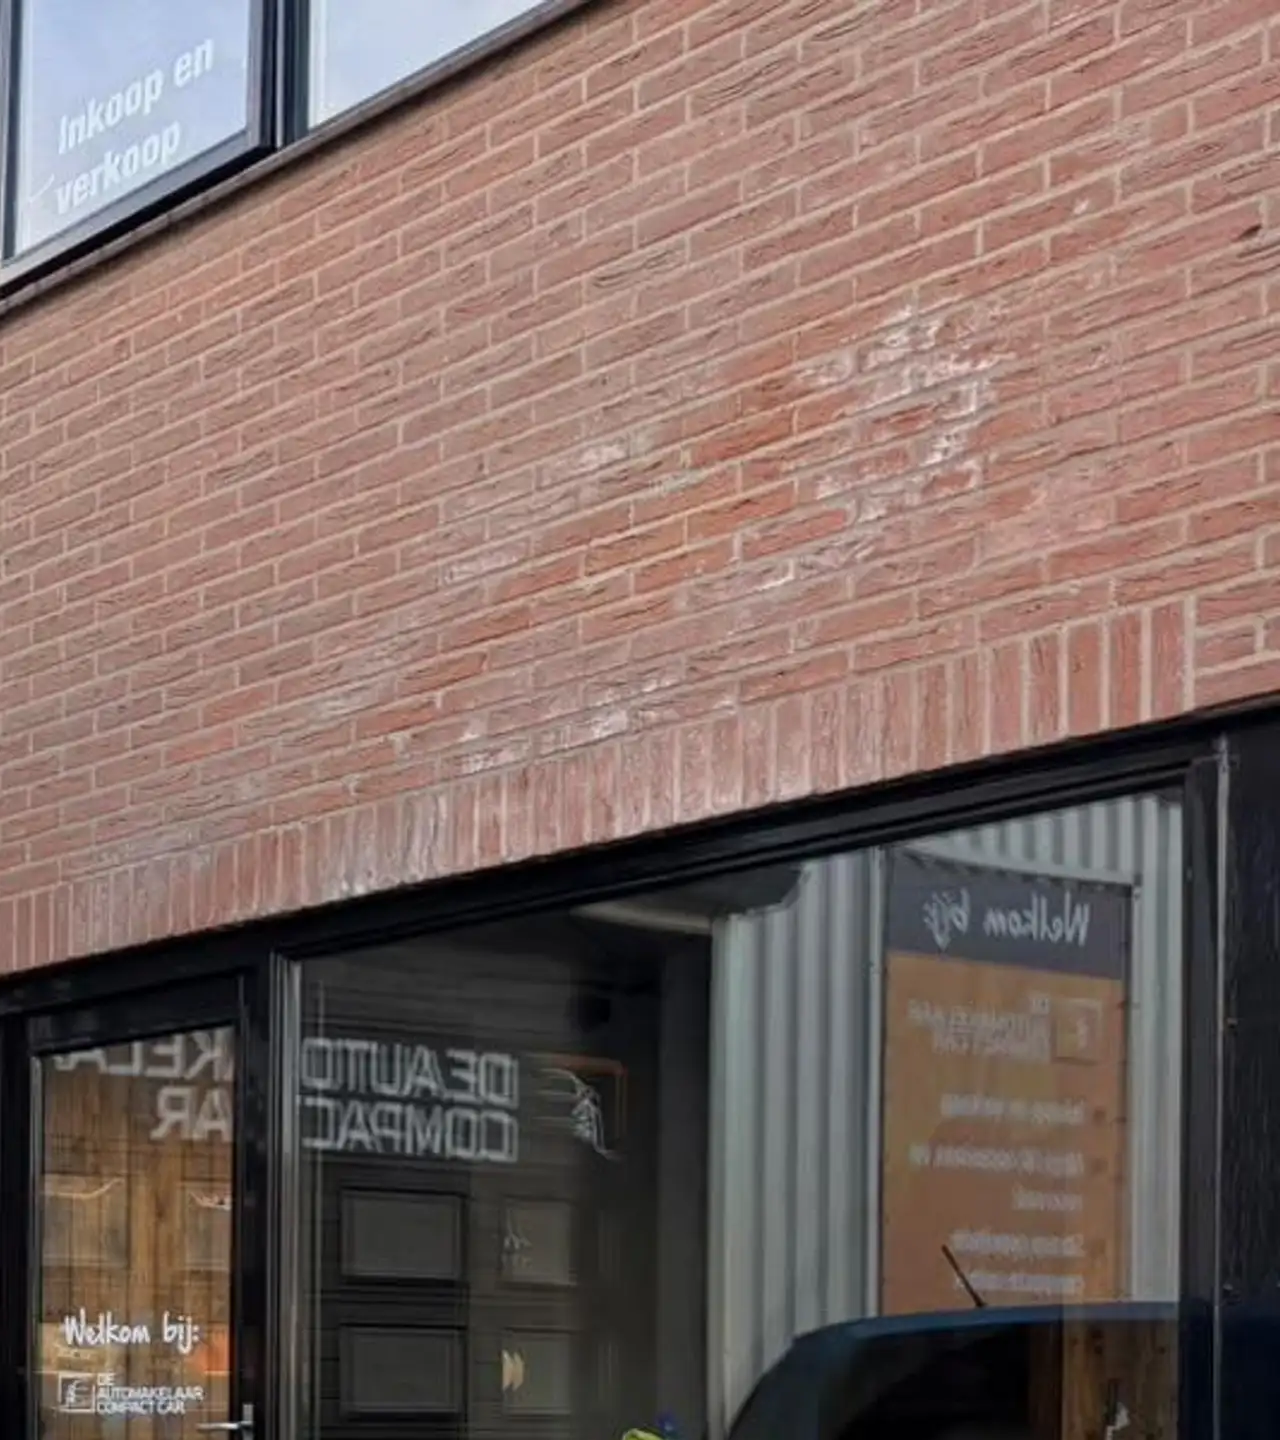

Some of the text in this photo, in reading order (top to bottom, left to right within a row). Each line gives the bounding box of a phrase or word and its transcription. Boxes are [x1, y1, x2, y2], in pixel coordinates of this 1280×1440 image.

[58, 38, 214, 155] Inkoop en
[55, 120, 182, 214] verkoop
[64, 1308, 151, 1346] Welkom
[97, 1384, 205, 1401] AUTOMAKELAAR
